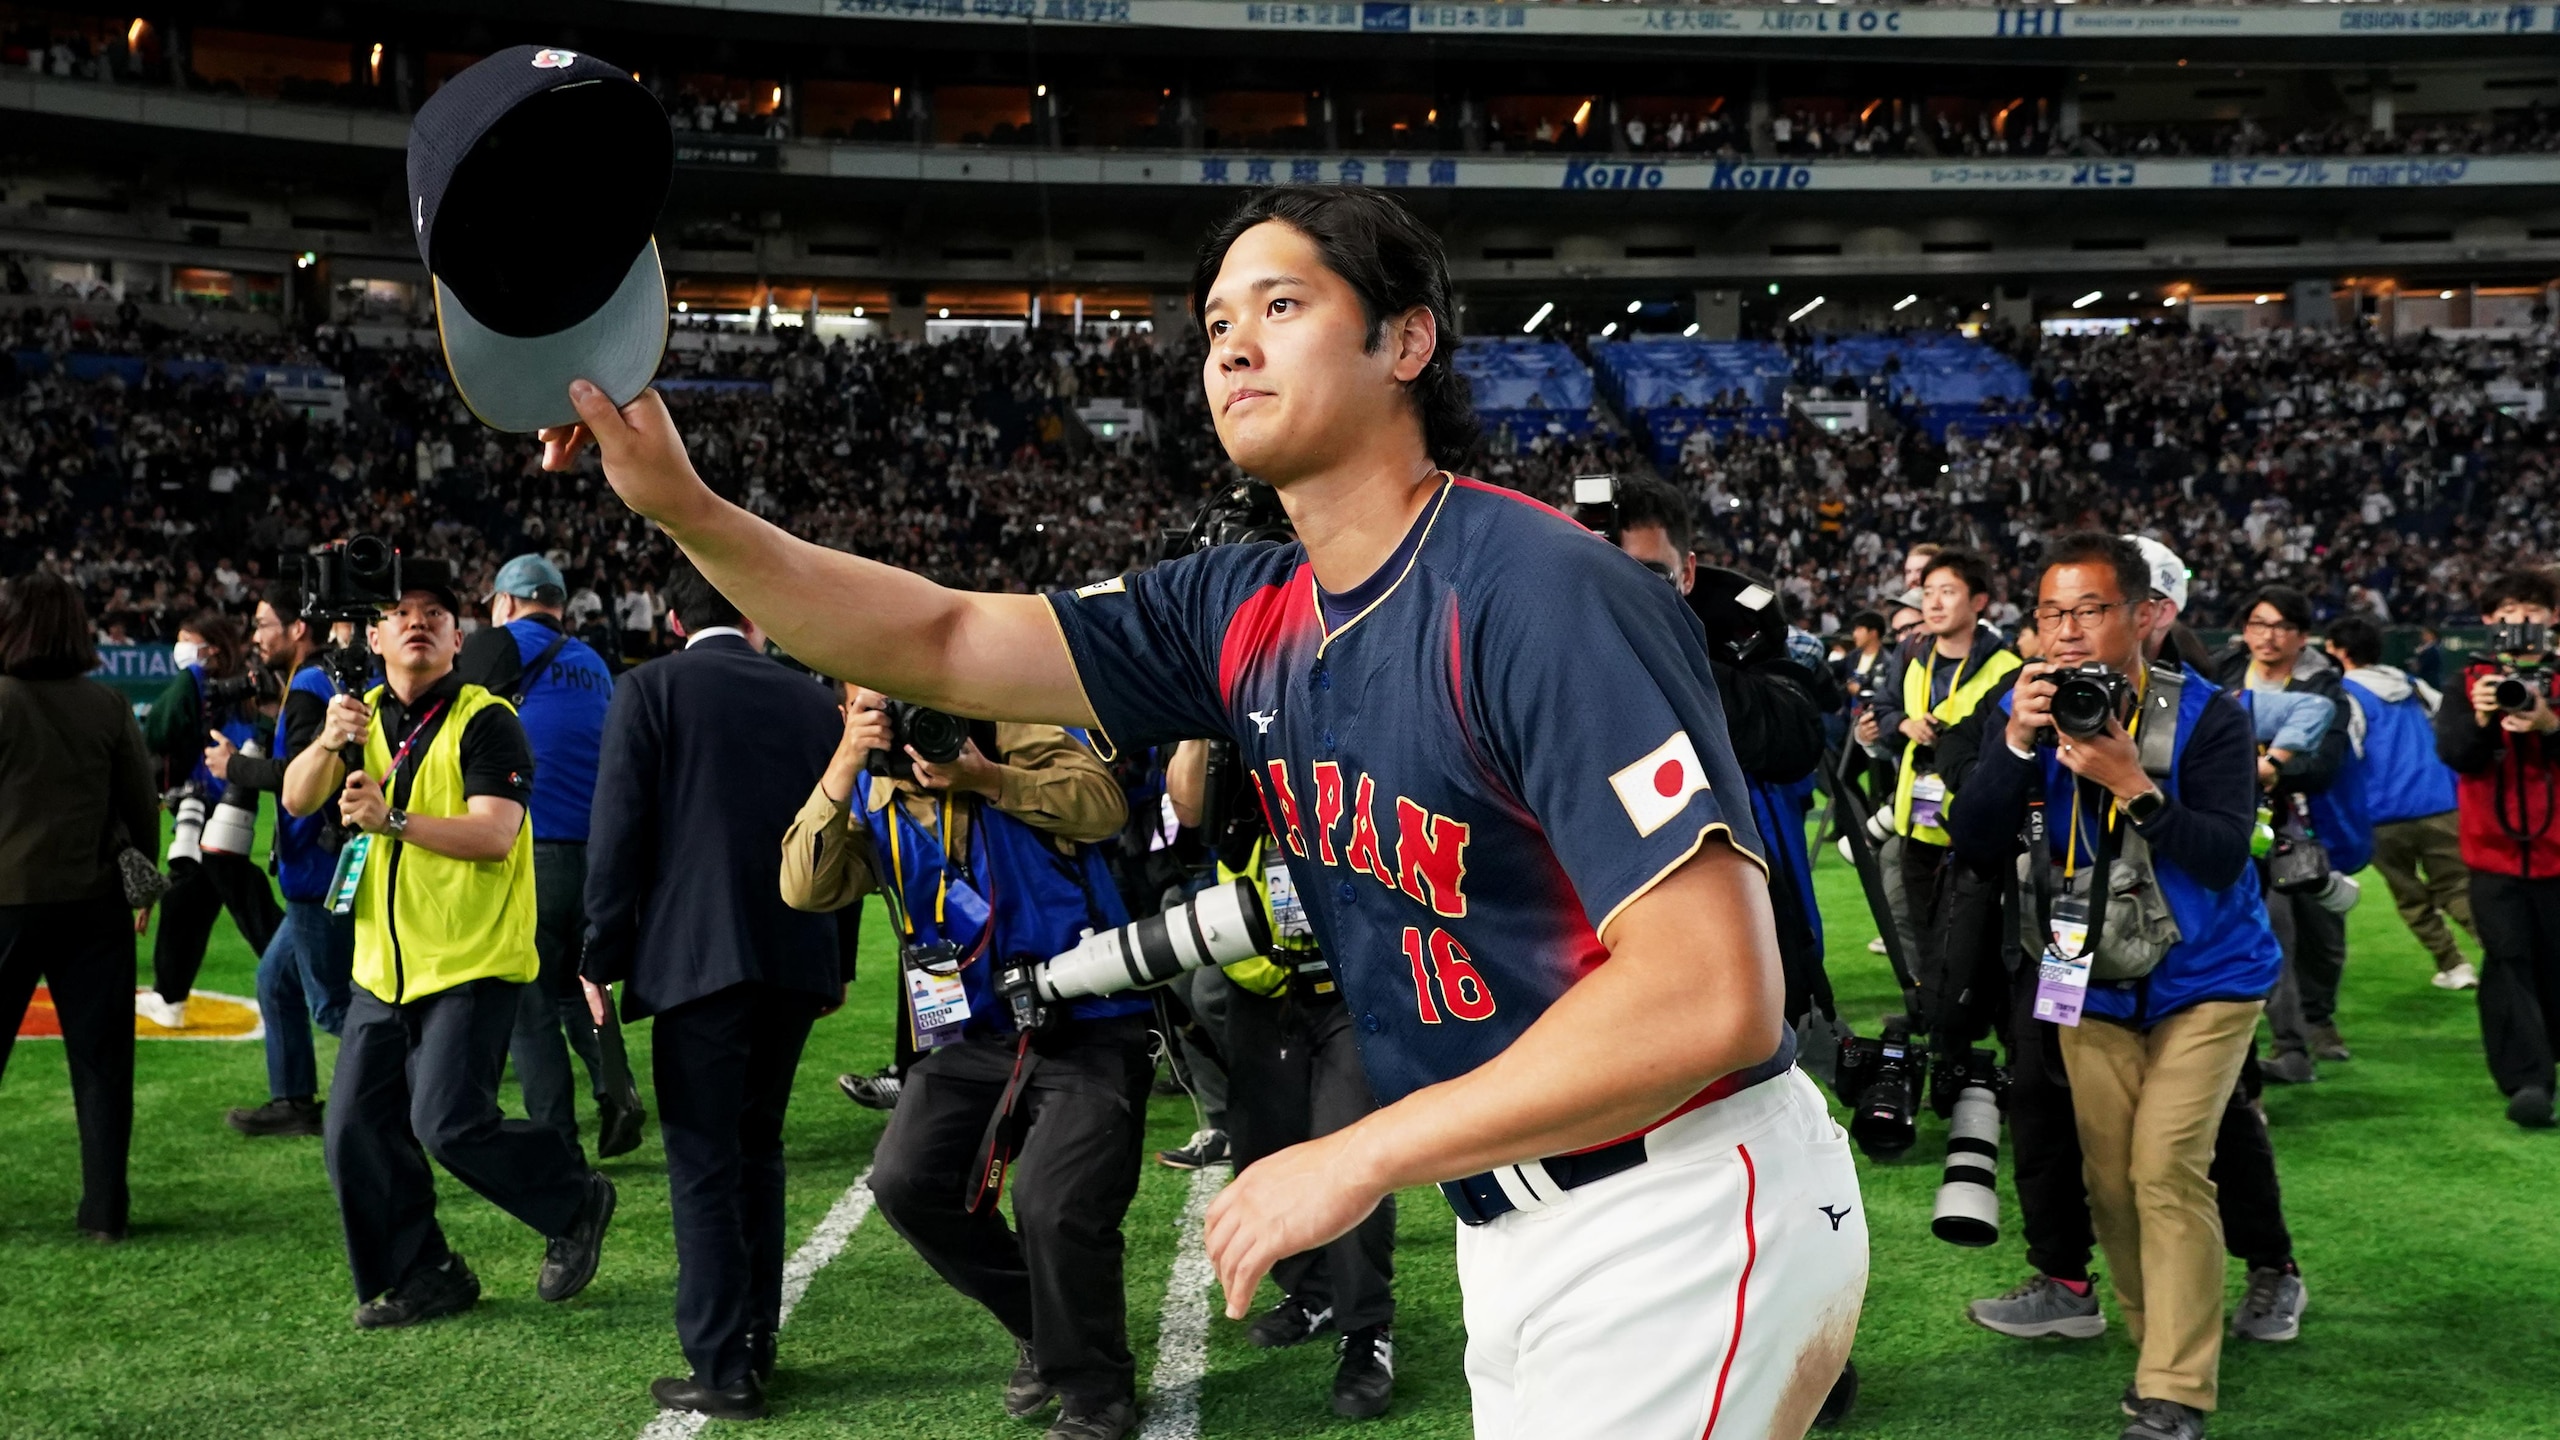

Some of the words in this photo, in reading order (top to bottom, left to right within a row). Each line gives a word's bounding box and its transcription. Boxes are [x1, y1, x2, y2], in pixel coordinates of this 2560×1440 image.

[1997, 8, 2064, 36] IHI
[86, 651, 179, 676] NTIAL
[551, 661, 612, 702] PHOTO
[1402, 926, 1496, 1024] 16
